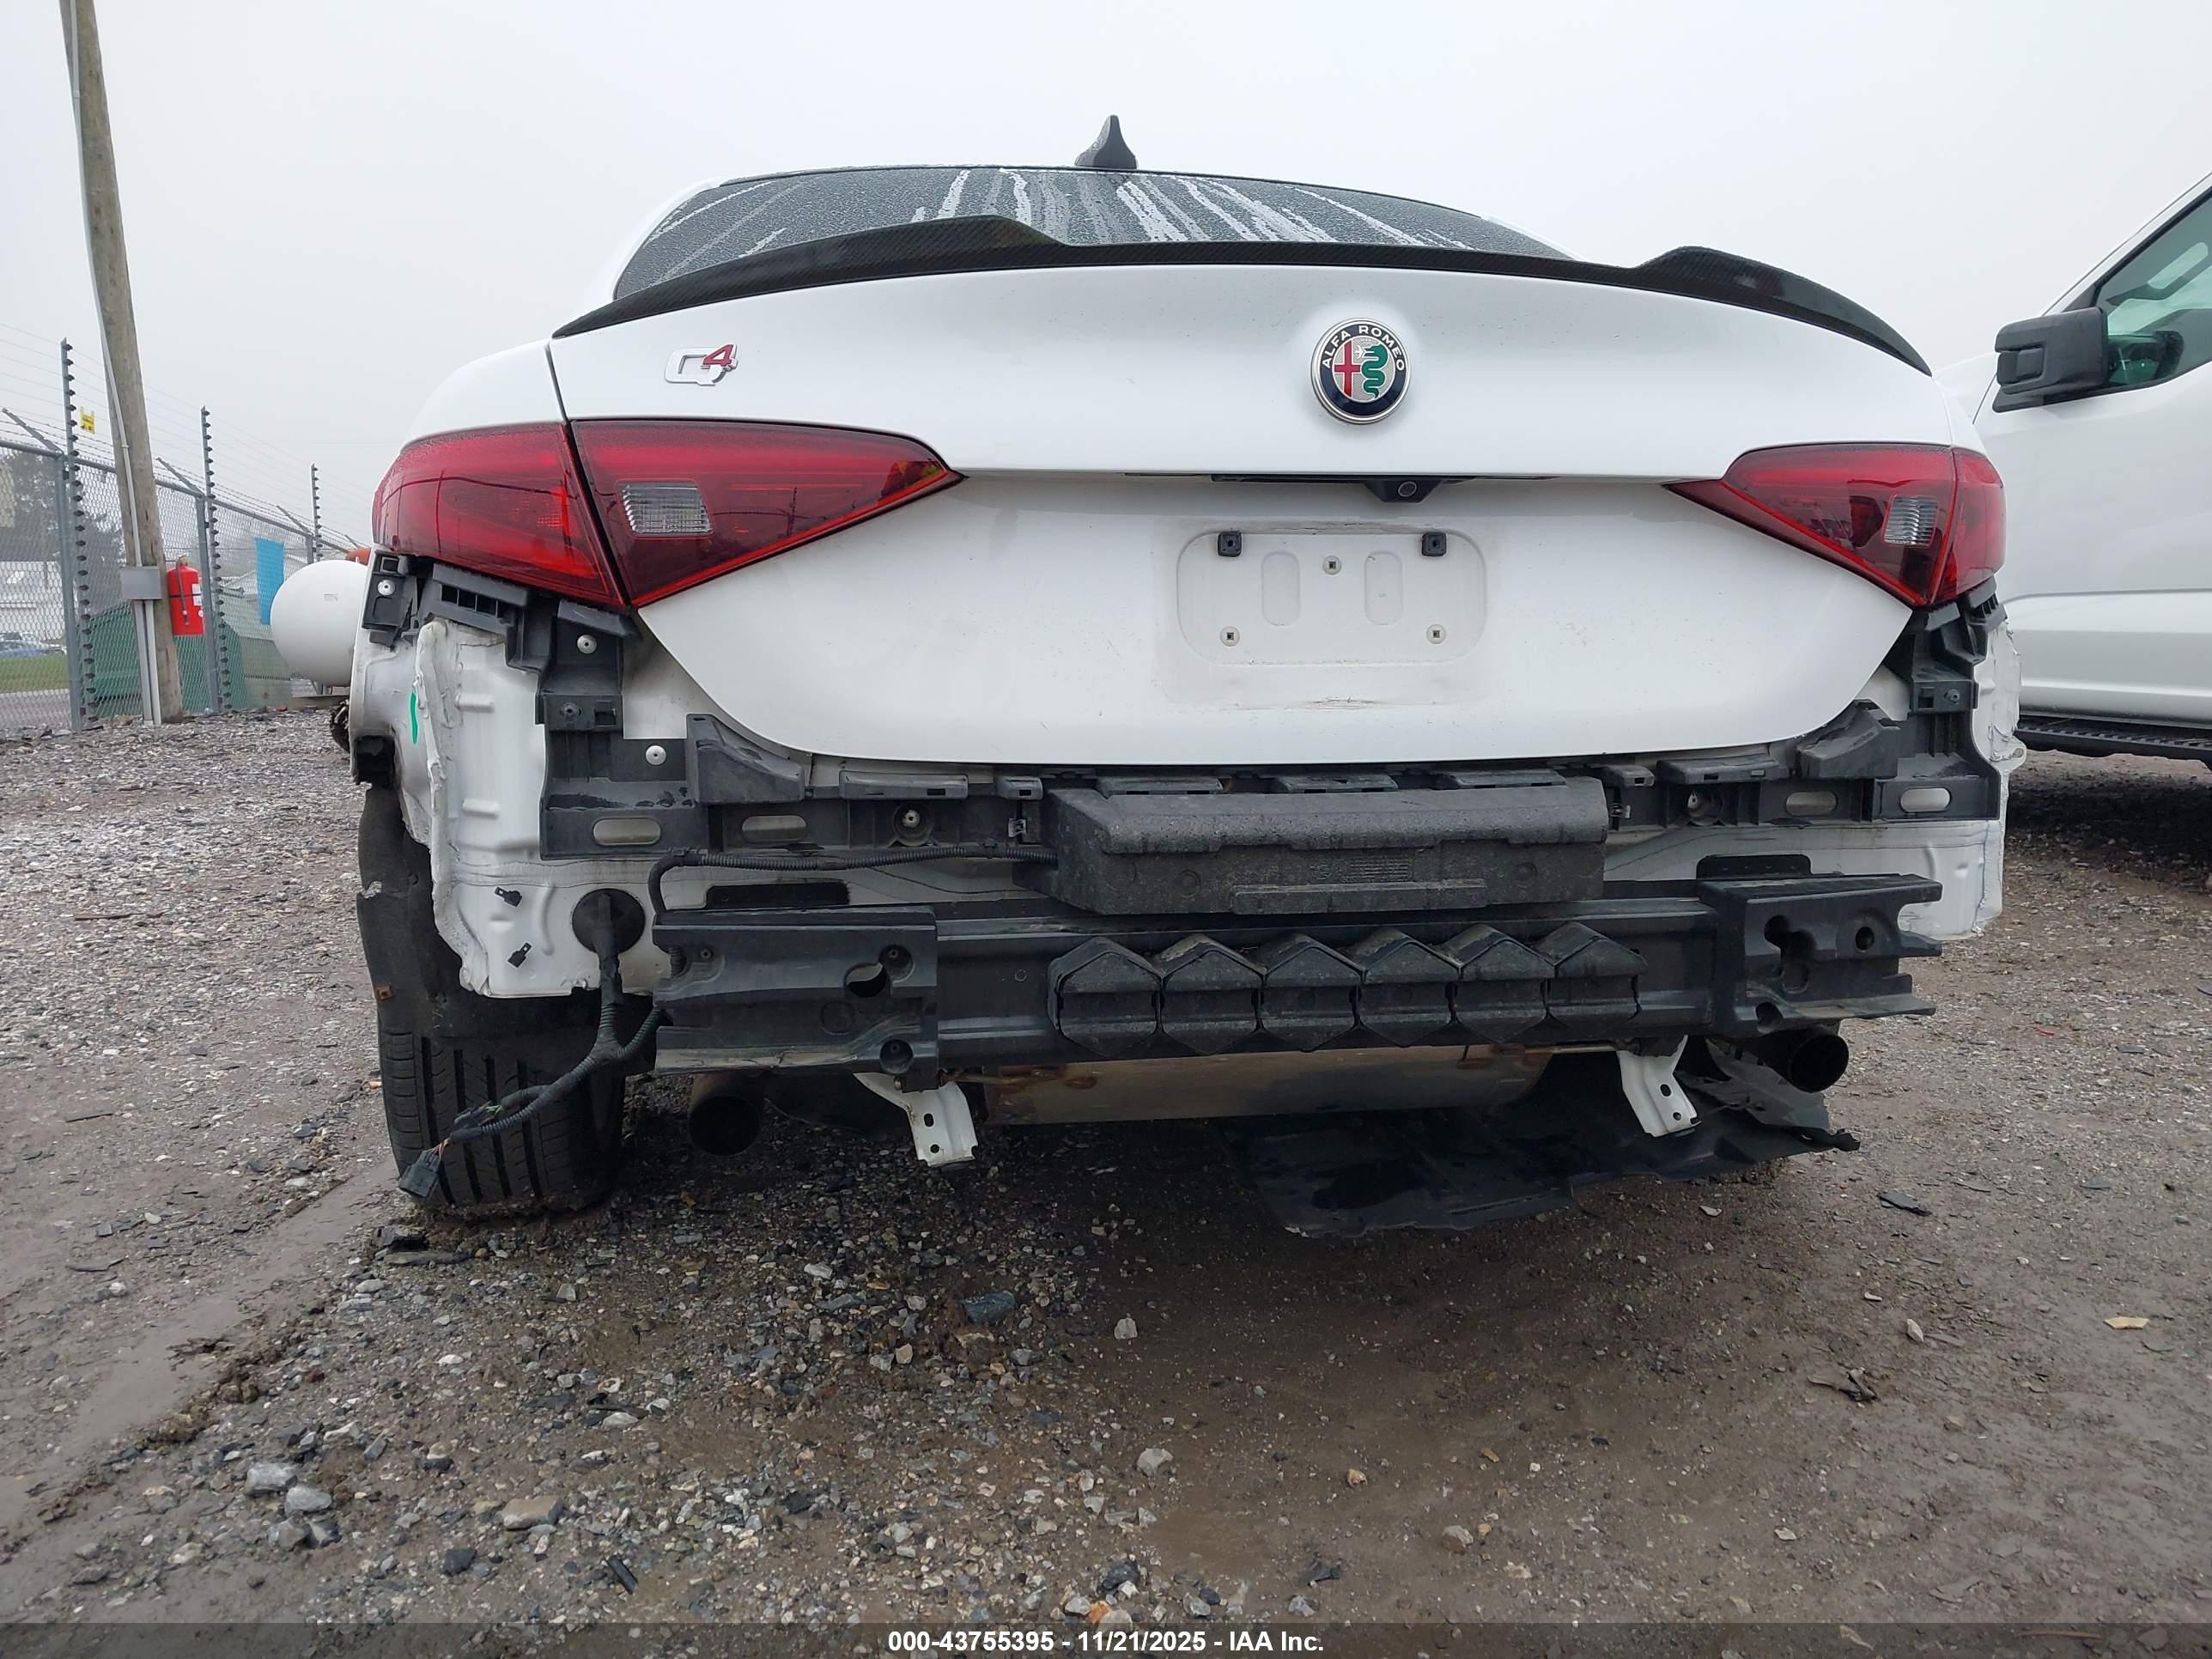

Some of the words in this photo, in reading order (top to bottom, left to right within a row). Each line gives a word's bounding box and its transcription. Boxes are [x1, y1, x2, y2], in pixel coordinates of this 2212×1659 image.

[665, 343, 738, 386] Q4
[1322, 330, 1352, 369] ALFA
[1358, 325, 1405, 371] ROMEO
